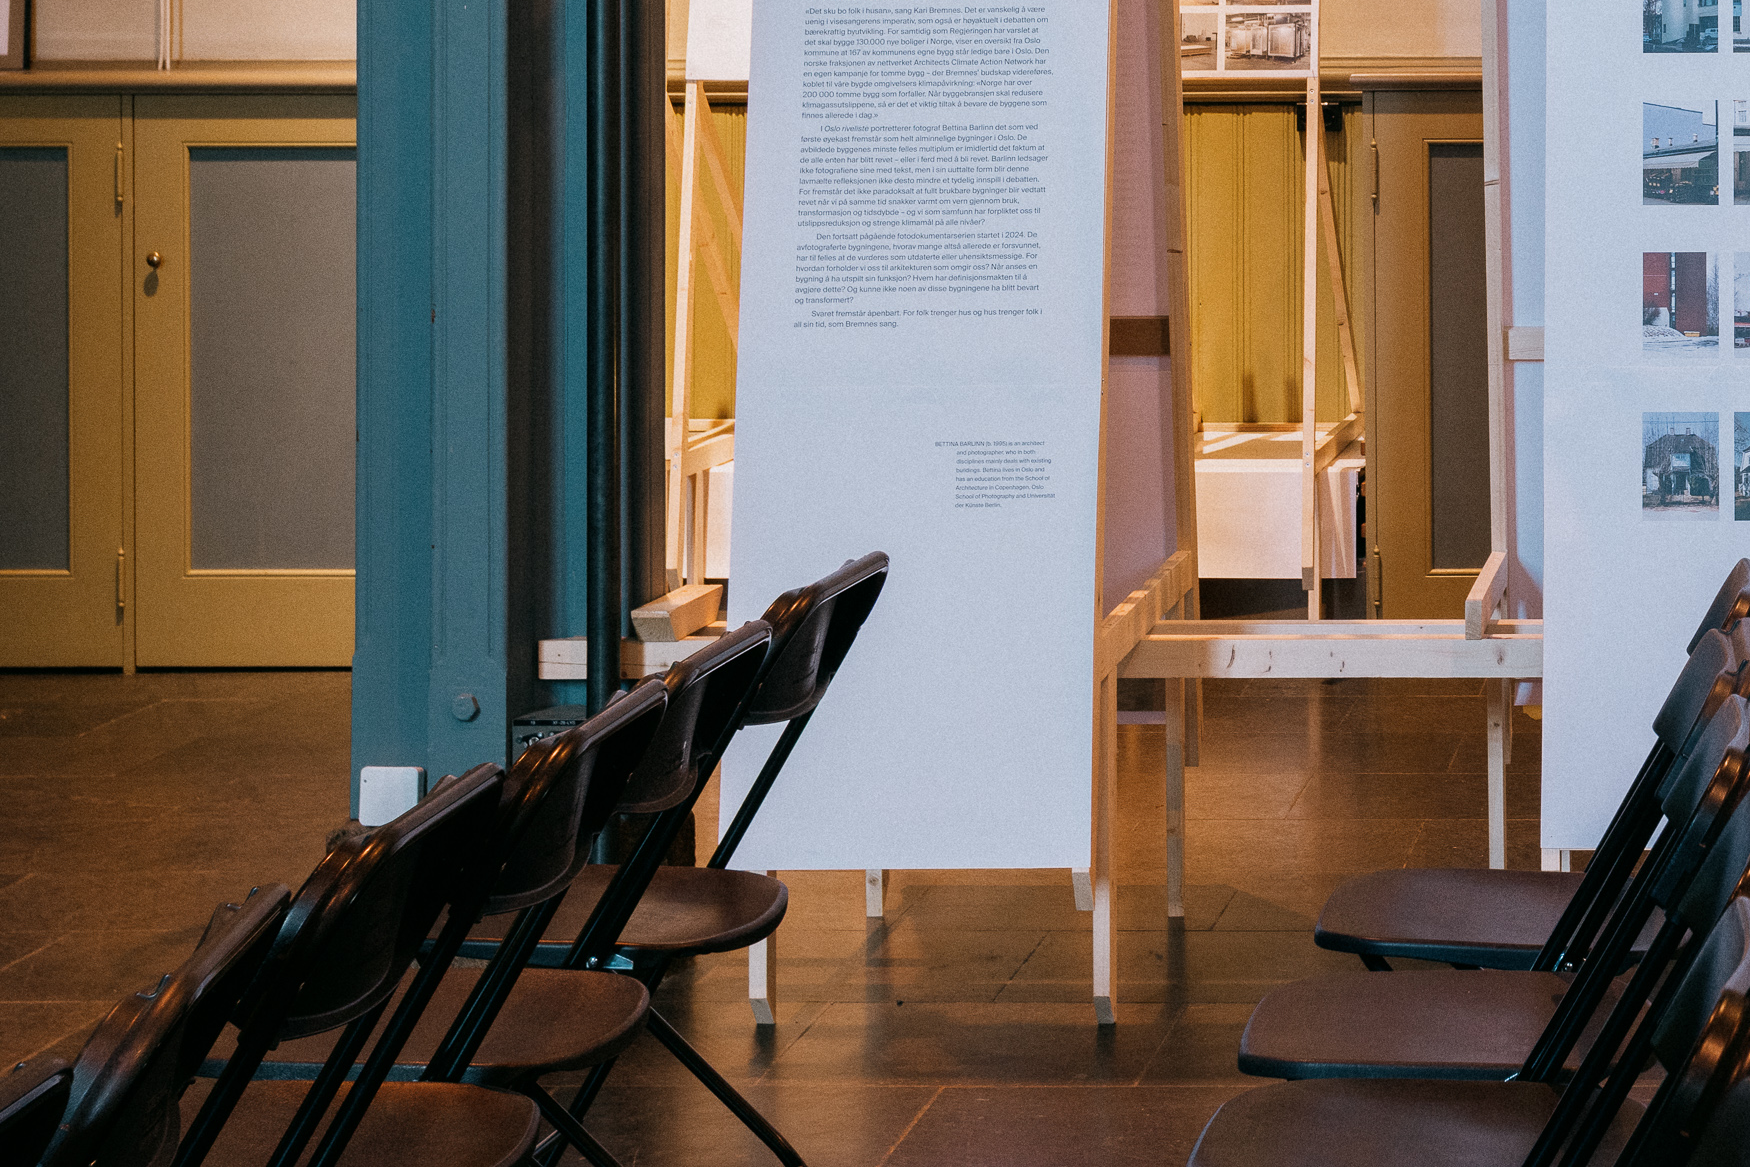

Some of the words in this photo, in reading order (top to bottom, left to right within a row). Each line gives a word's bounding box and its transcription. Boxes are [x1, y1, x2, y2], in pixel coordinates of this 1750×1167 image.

[811, 310, 834, 318] Svaret
[835, 310, 866, 318] fremstår
[867, 310, 901, 319] åpenbart.
[916, 309, 929, 317] folk
[930, 309, 957, 319] trenger
[958, 309, 972, 317] hus
[972, 310, 983, 318] og
[998, 309, 1024, 318] trenger
[1025, 308, 1039, 316] folk
[1040, 308, 1043, 316] i
[793, 321, 802, 329] all
[803, 321, 814, 329] sin
[815, 321, 827, 330] tid,
[879, 322, 899, 330] sang.
